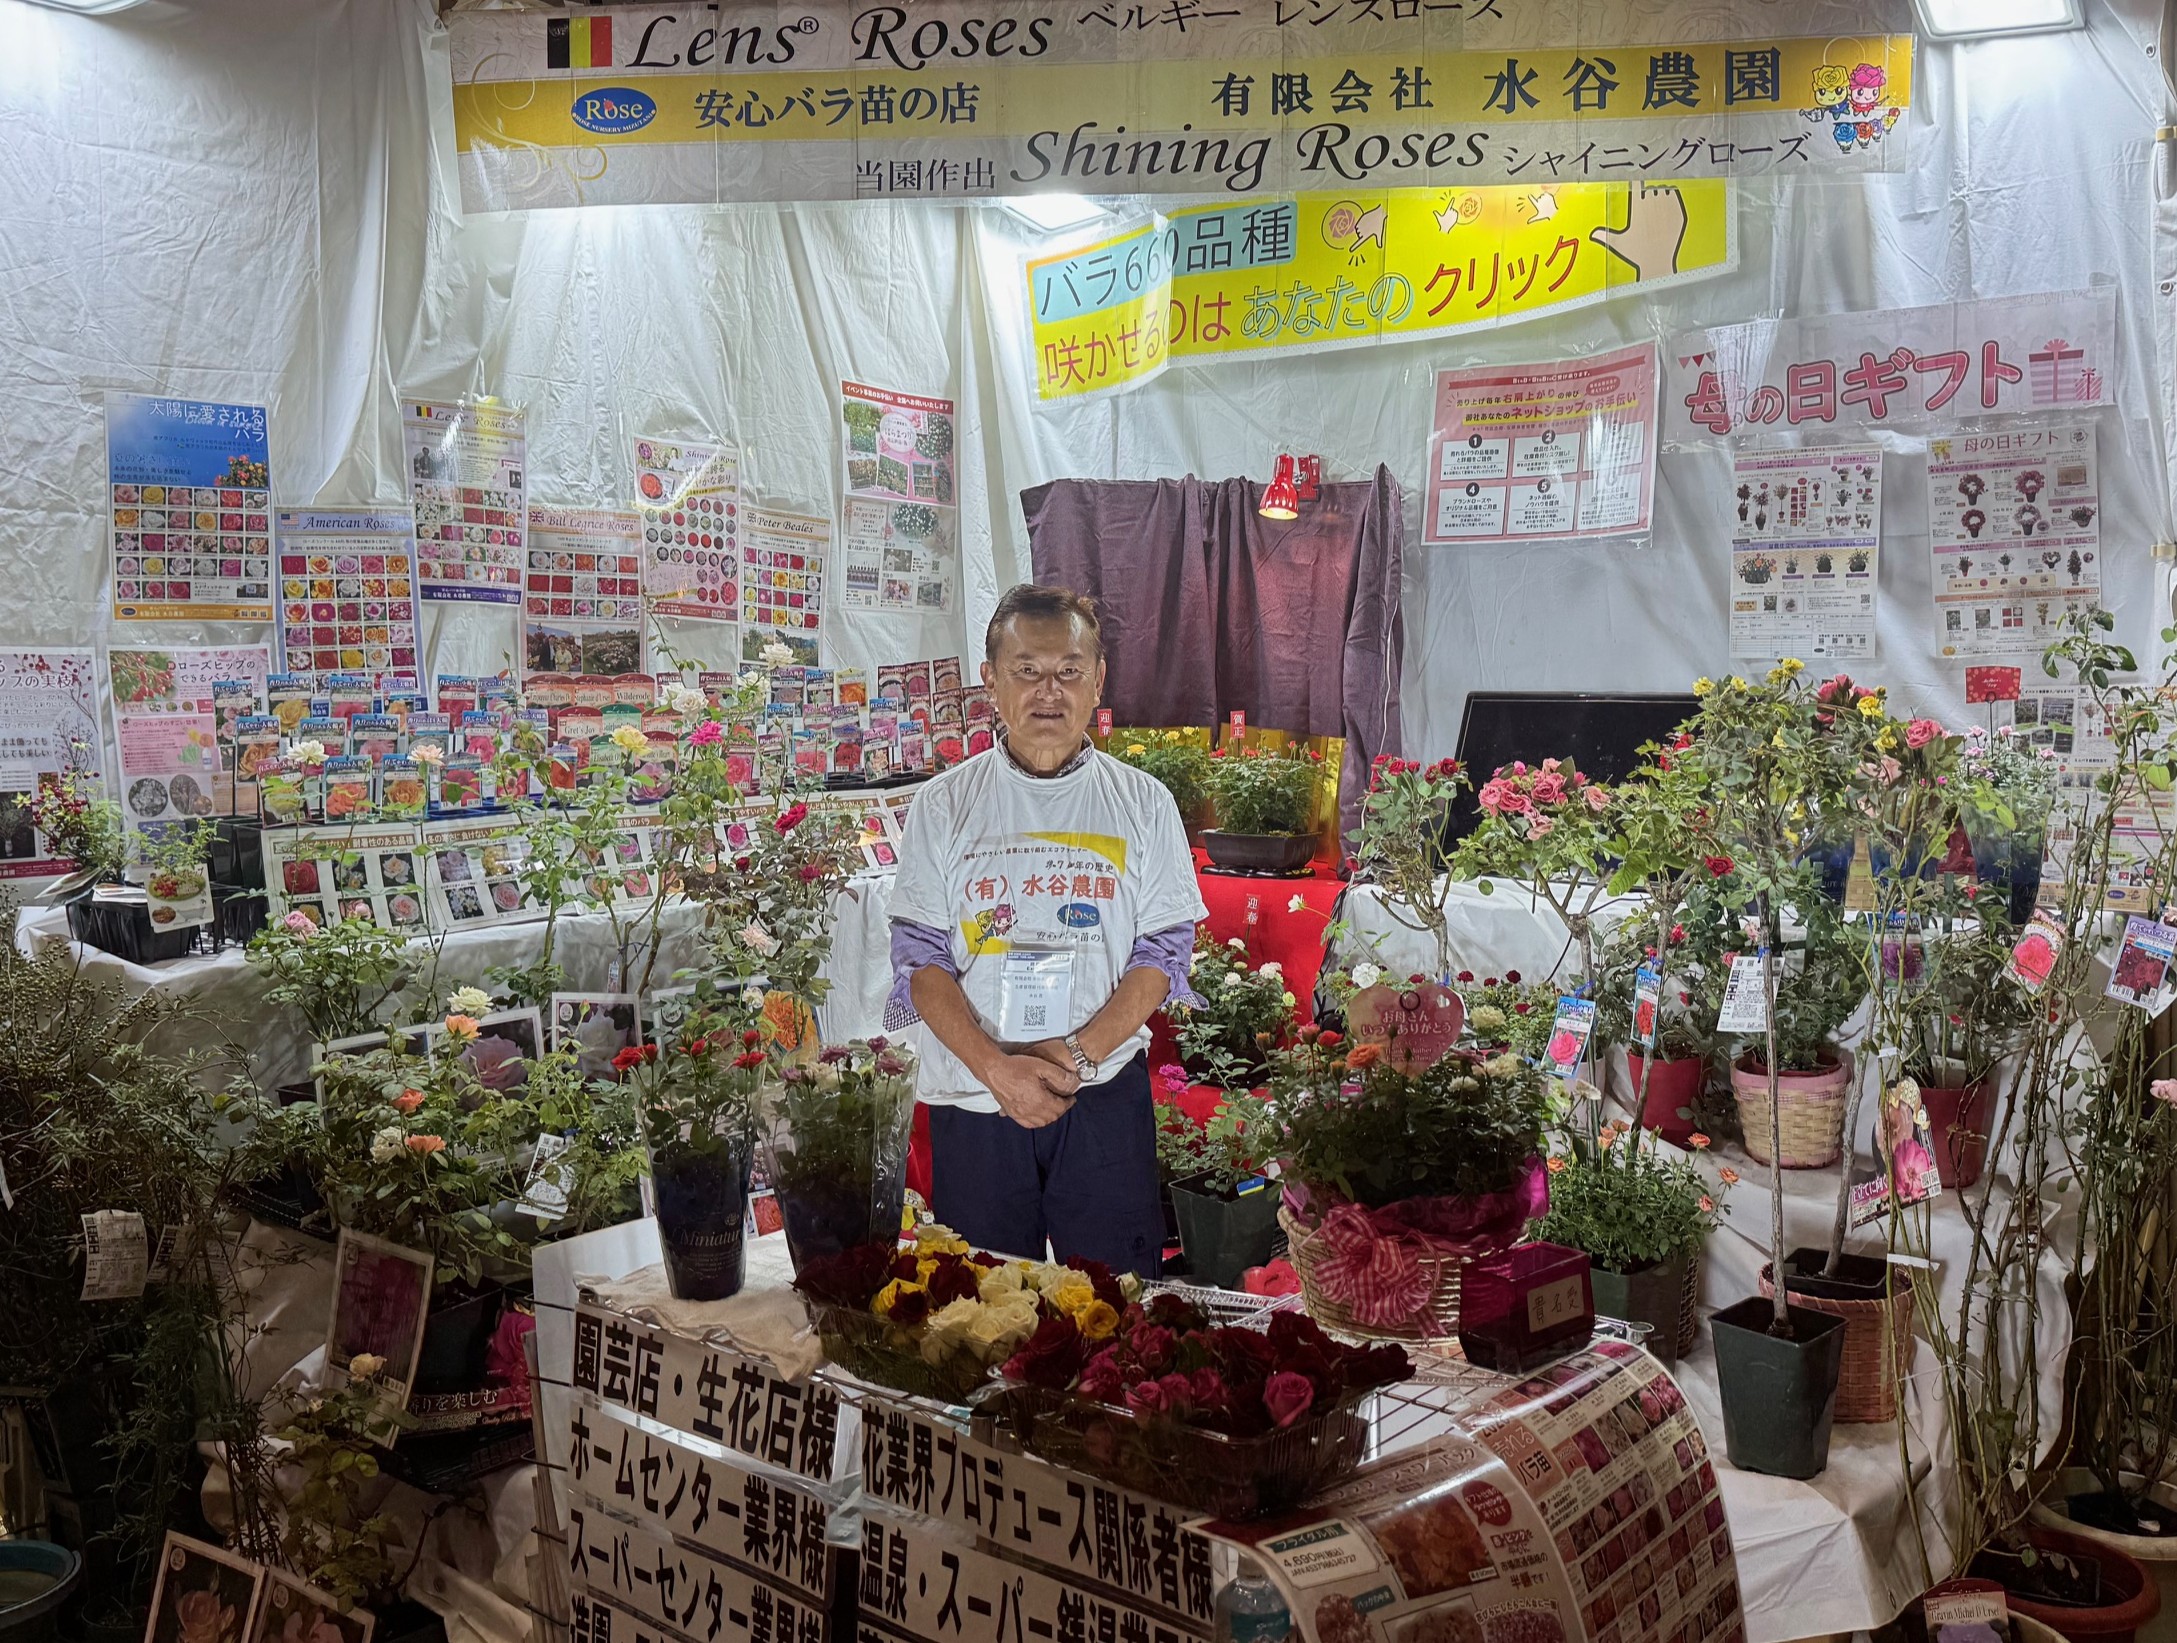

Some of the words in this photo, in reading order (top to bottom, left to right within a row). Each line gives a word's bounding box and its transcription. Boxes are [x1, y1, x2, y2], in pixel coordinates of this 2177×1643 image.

[1077, 2, 1242, 33] ベルギー
[852, 7, 1052, 72] Roses
[1211, 66, 1434, 117] 有限会社
[1483, 46, 1782, 113] 水谷農園
[584, 97, 643, 121] Rose
[695, 83, 980, 130] 安心バラ苗の店
[591, 124, 621, 133] NURSERY
[622, 112, 653, 132] MIZUTANI
[1010, 122, 1271, 191] Shining
[1297, 121, 1491, 182] Roses
[1500, 130, 1811, 179] シャイニングローズ
[856, 157, 996, 193] 当園作出
[1039, 203, 1295, 317] バラ660品種
[1044, 289, 1233, 391] 咲かせるのは
[1239, 270, 1414, 339] あなたの
[1426, 233, 1581, 318] クリック
[1685, 339, 2023, 437] 母の日ギフト
[473, 416, 506, 430] Roses
[1964, 430, 2060, 453] 母の日ギフト
[303, 516, 360, 530] American
[364, 517, 395, 531] Roses
[547, 515, 567, 527] Bill
[607, 520, 635, 532] Roses
[757, 516, 782, 529] Peter
[783, 520, 814, 534] Beales
[178, 660, 256, 672] ローズヒップの
[180, 671, 232, 683] できるバラ
[616, 691, 650, 701] Wilderode
[564, 725, 584, 735] Gret's
[585, 726, 596, 736] Joy
[1100, 712, 1112, 737] 迎春
[1233, 713, 1244, 737] 賀正
[1022, 873, 1116, 900] 水谷農園
[1064, 908, 1096, 921] Rose
[1247, 896, 1259, 924] 迎春
[1361, 1021, 1452, 1036] いつありがとう
[1382, 1009, 1430, 1024] お母さん
[573, 1311, 840, 1483] 園芸店・生花店様
[1490, 1425, 1535, 1459] 売れる
[1516, 1450, 1553, 1486] バラ苗
[570, 1407, 827, 1595] ホームセンター業界様
[862, 1402, 1214, 1623] 花業界プロデュース関係者様
